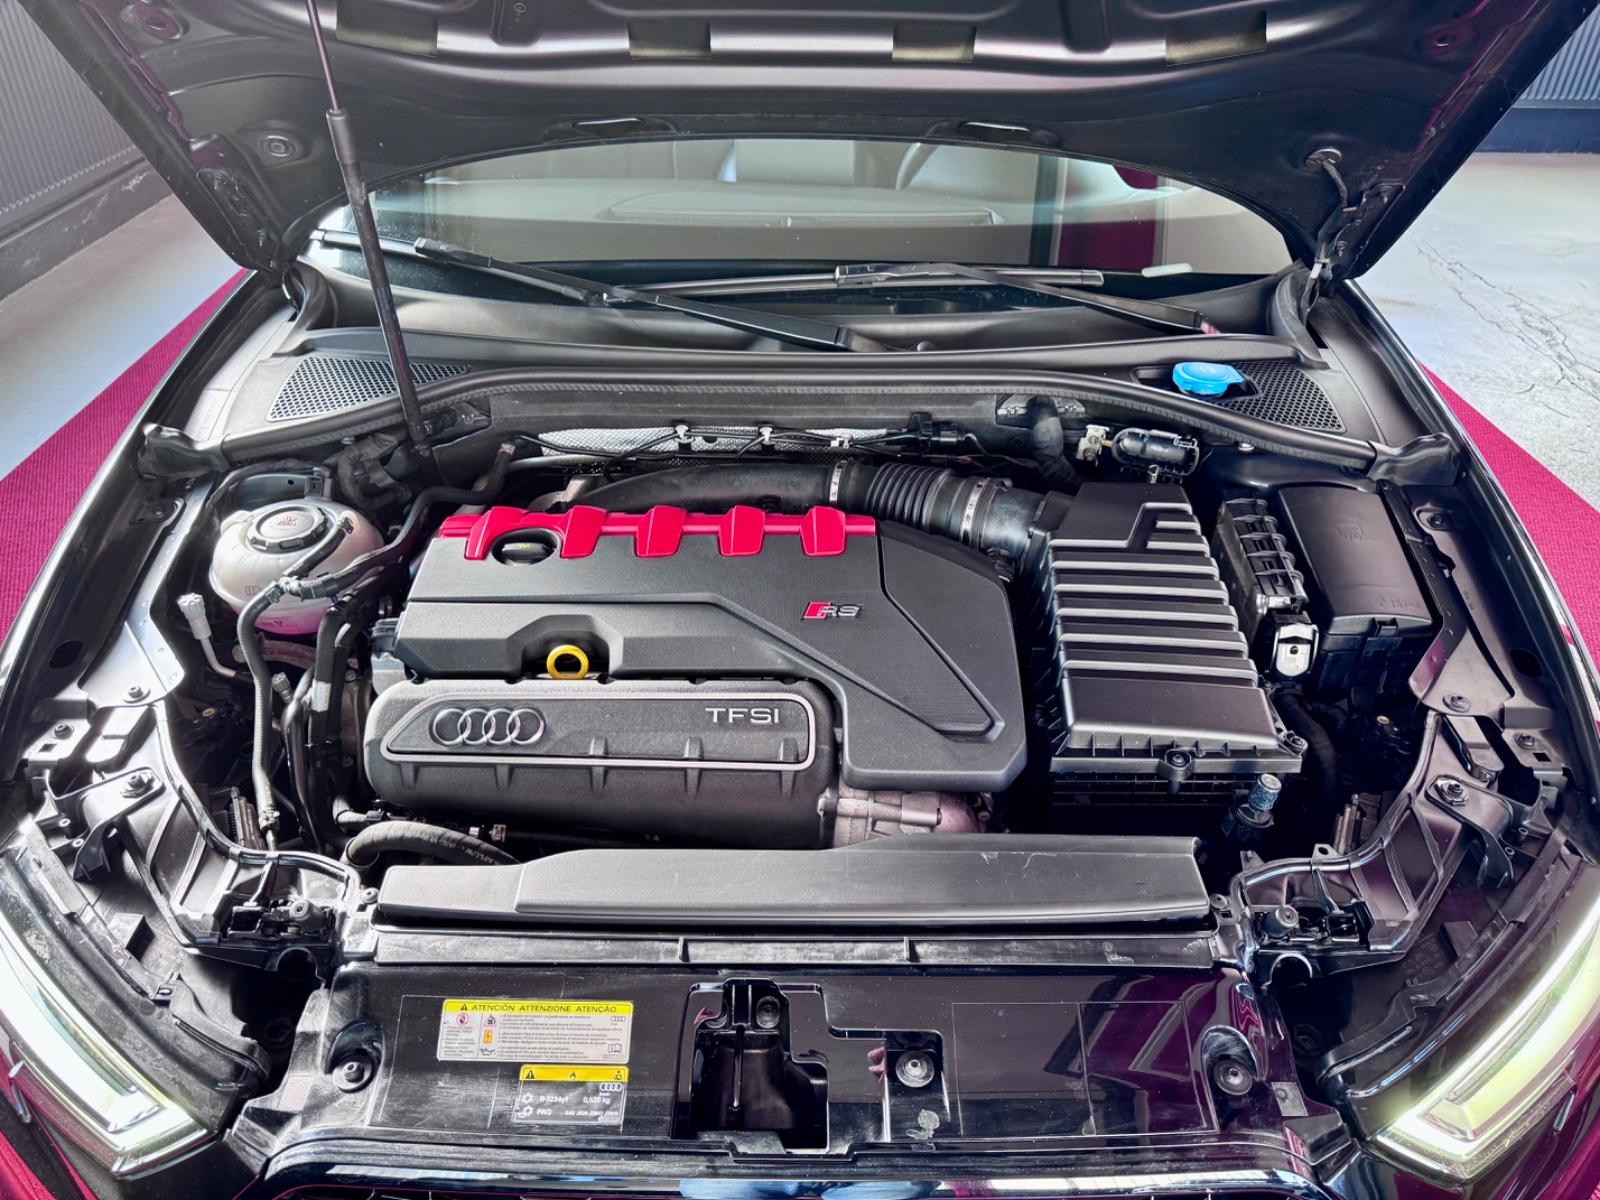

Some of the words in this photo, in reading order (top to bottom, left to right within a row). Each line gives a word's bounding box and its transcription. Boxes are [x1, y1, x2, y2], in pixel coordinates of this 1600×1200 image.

[804, 602, 860, 618] RS
[705, 707, 780, 725] TFSI
[471, 1003, 515, 1012] ATENCIÓN
[519, 1004, 572, 1013] ATTENZIONE
